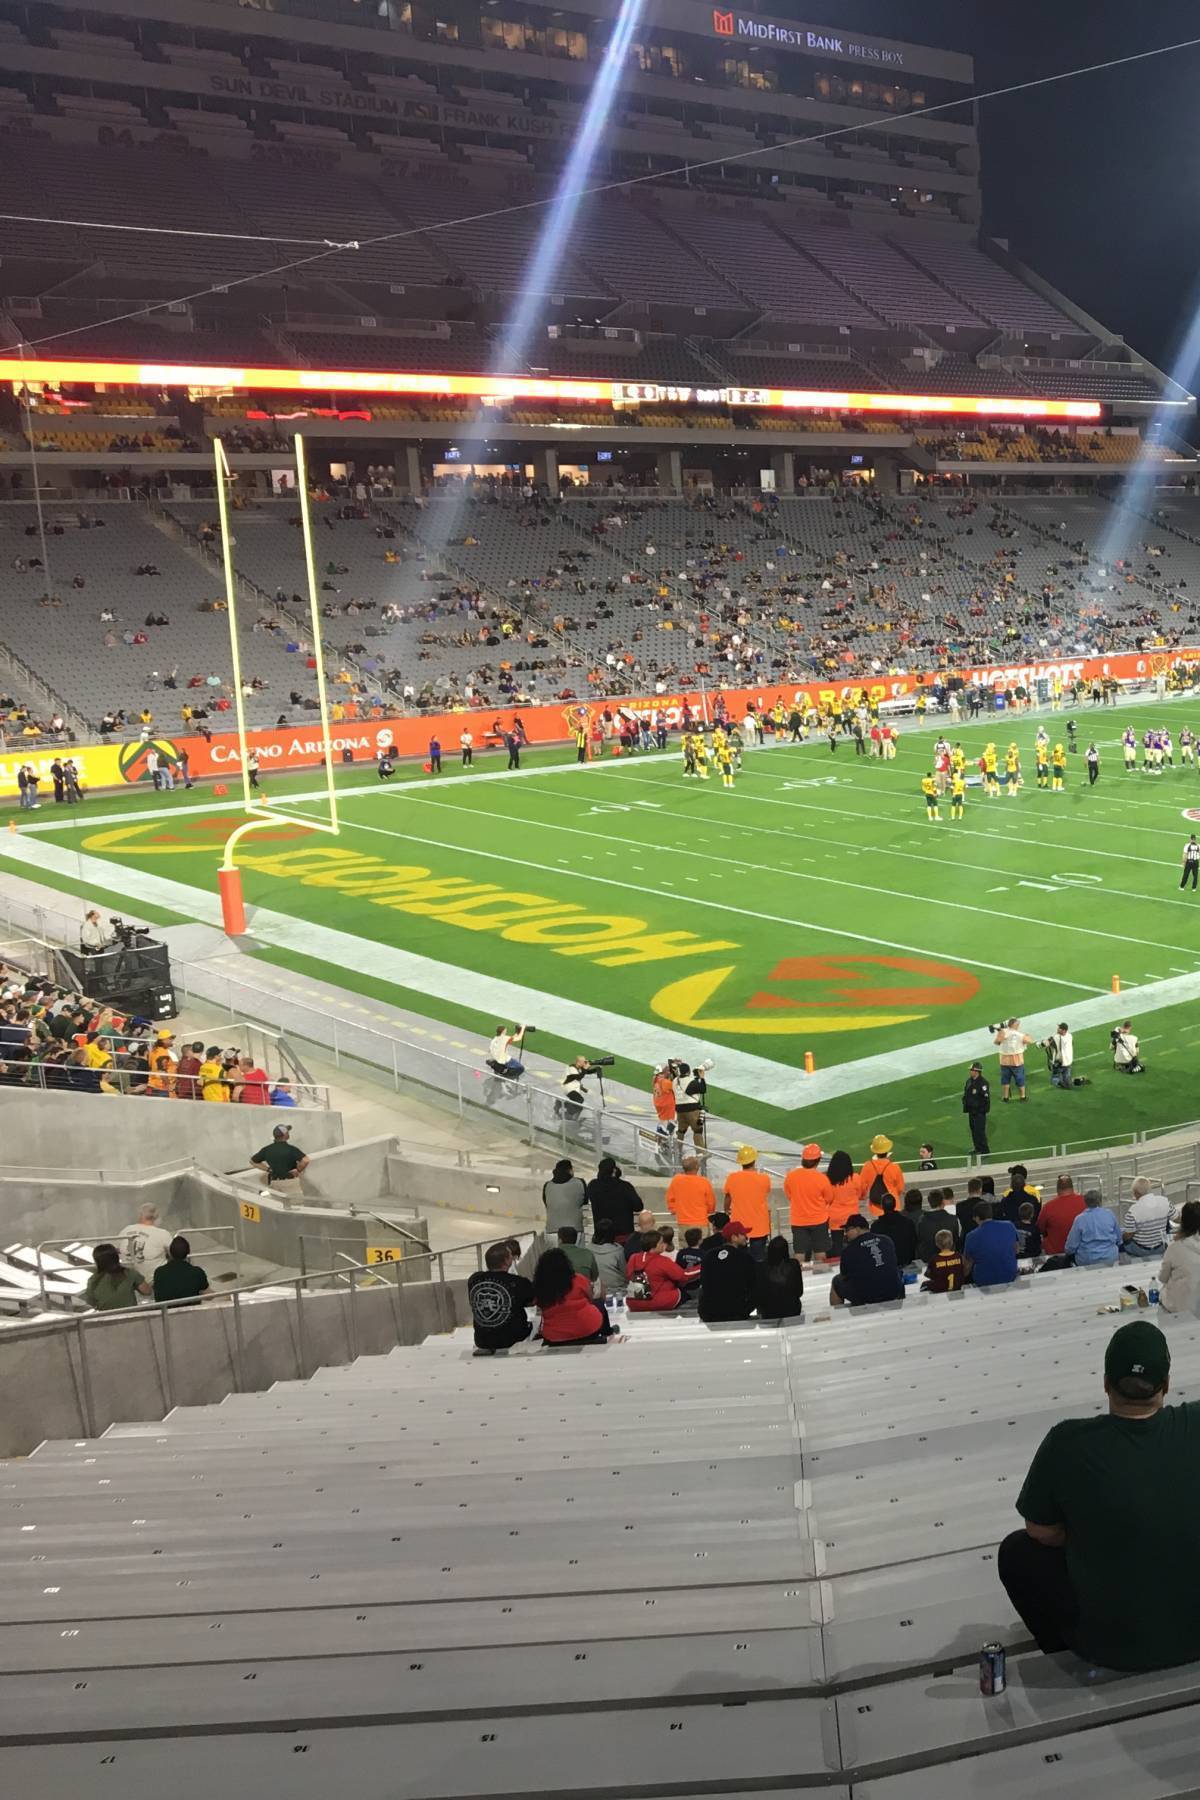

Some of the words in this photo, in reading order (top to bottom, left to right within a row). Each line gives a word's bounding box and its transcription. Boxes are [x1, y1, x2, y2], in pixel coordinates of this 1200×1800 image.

[848, 44, 879, 59] PRESS
[882, 50, 904, 64] BOX
[211, 76, 253, 94] SUN
[261, 83, 312, 103] DEVIL
[320, 90, 398, 113] STADIUM
[444, 108, 500, 129] FRANK
[244, 1204, 255, 1219] 37
[375, 1250, 394, 1263] 36
[947, 1273, 954, 1290] 1
